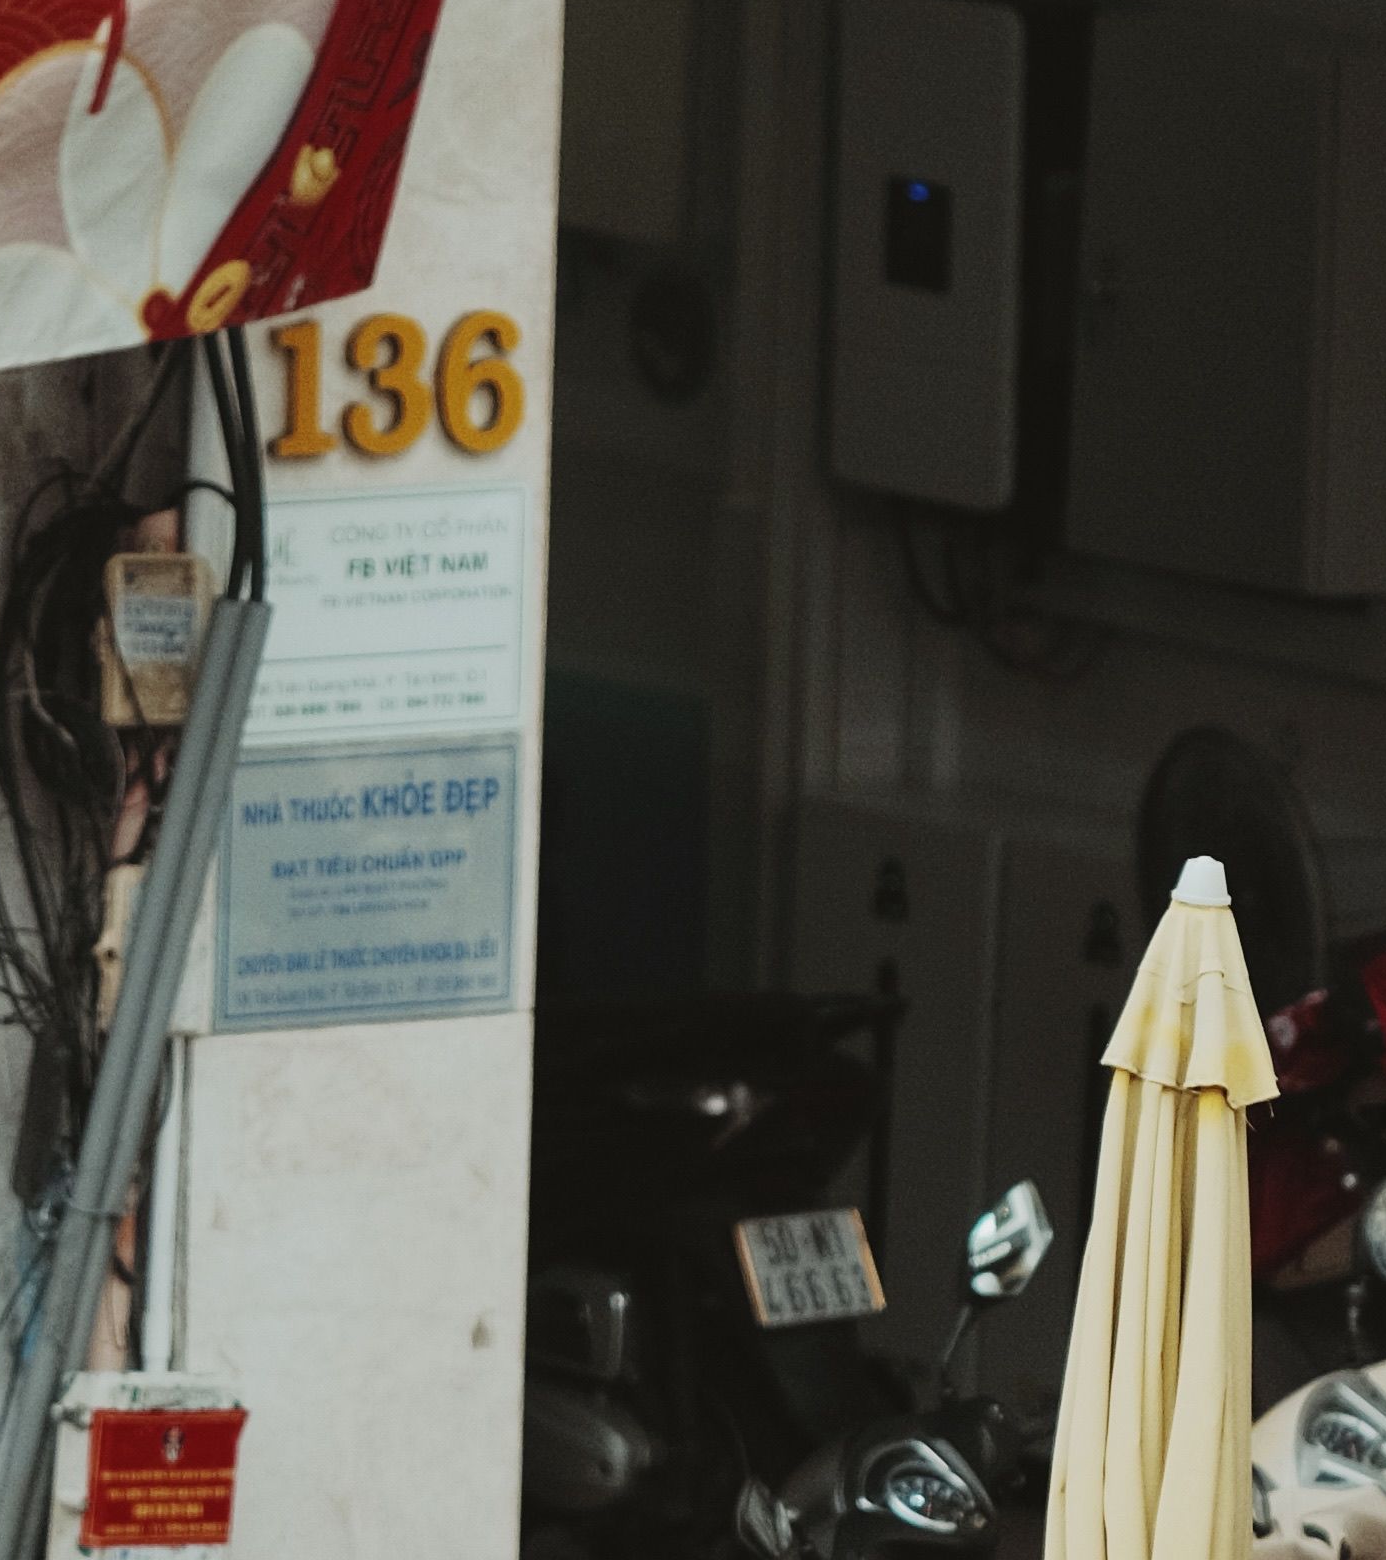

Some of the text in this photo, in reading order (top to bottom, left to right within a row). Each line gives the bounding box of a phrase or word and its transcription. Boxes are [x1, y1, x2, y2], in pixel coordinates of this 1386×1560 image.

[269, 310, 527, 458] 136
[346, 548, 490, 580] FB VIỆT NAM
[360, 770, 437, 819] KHỎE
[441, 776, 501, 818] ĐẸP
